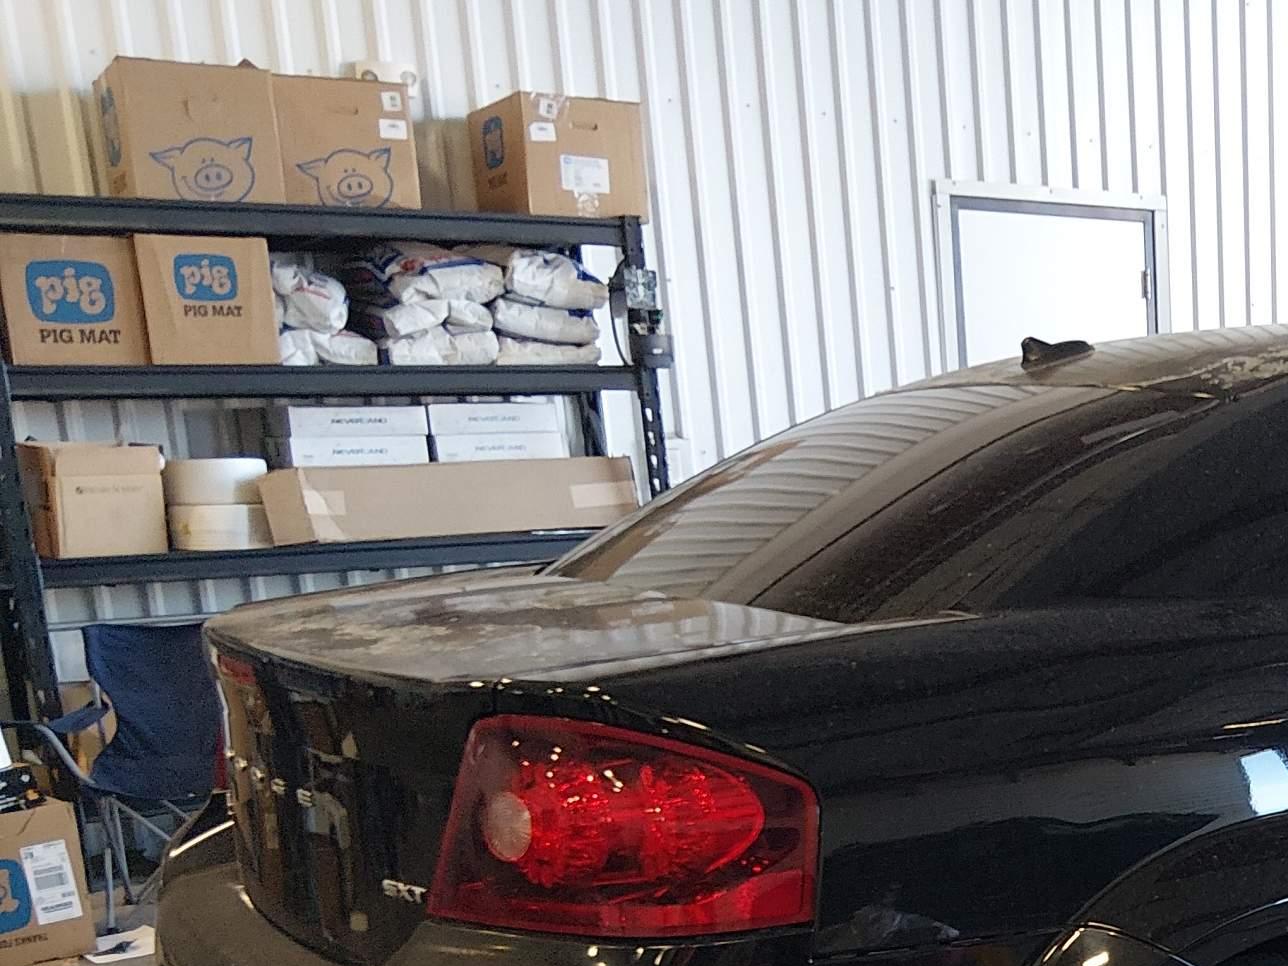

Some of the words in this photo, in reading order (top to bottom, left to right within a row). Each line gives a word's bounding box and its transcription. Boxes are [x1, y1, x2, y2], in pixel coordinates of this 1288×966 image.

[179, 258, 232, 296] pig
[35, 267, 106, 315] pig
[183, 304, 209, 318] PIG
[212, 304, 243, 318] MAT
[39, 328, 74, 345] PIG
[79, 328, 121, 345] MAT
